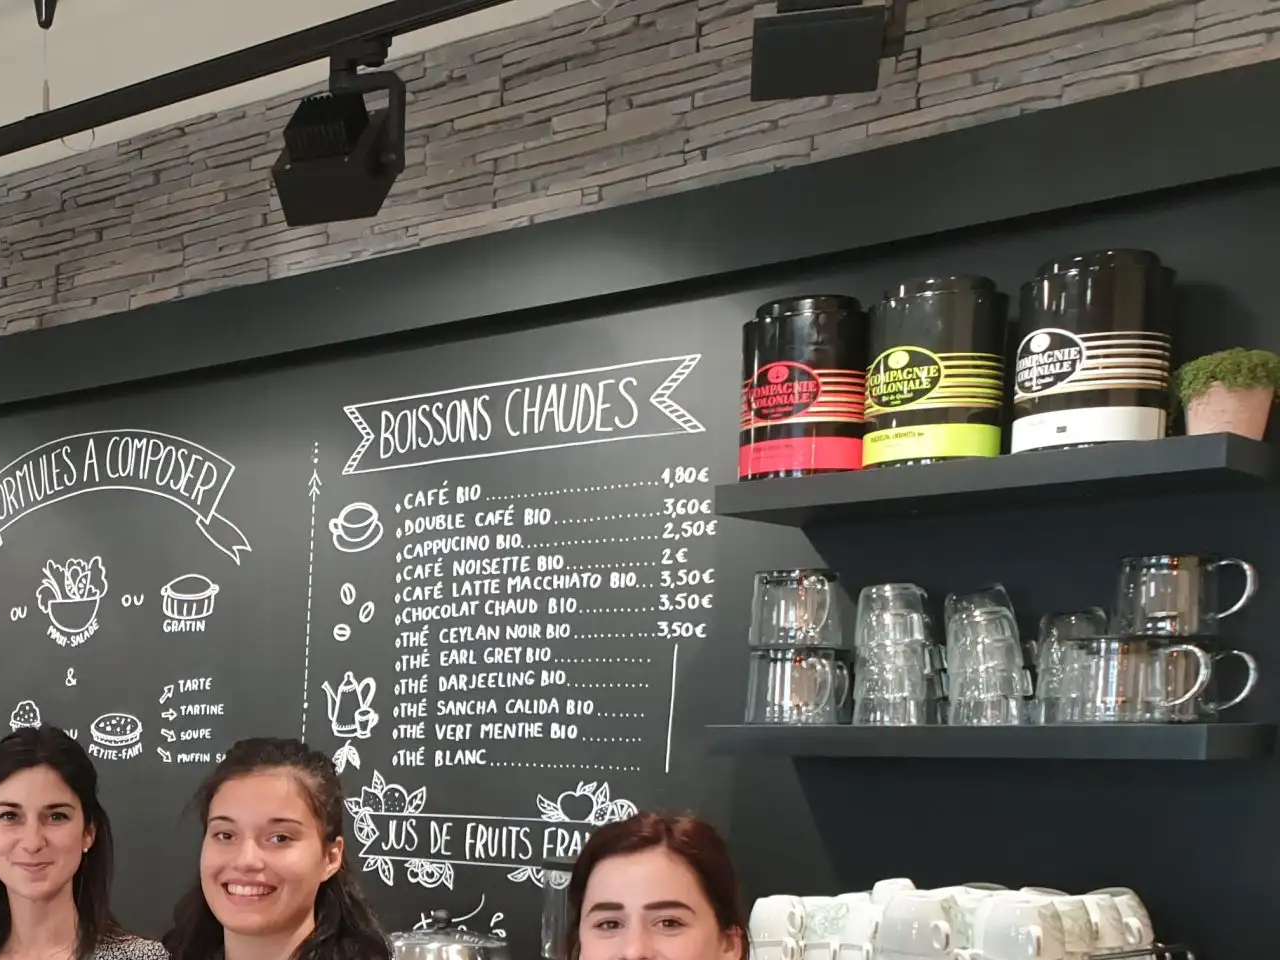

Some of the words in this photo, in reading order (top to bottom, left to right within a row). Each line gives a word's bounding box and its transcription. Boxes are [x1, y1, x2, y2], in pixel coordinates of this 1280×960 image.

[379, 395, 492, 459] BOISSONS
[504, 376, 639, 437] CHAUDES
[83, 438, 99, 483] A
[106, 436, 218, 508] COMPOSER
[404, 481, 449, 510] CAFÉ
[456, 485, 481, 505] BIO
[661, 467, 710, 489] 1,80€
[405, 512, 465, 535] DOUBLE
[475, 506, 515, 529] CAFÉ
[524, 509, 551, 526] BIO
[663, 499, 712, 519] 3,60€
[404, 535, 489, 560] CAPPUCINO
[496, 534, 521, 550] BIO
[662, 520, 718, 540] 2,50€
[404, 557, 445, 582] CAFÉ
[453, 556, 530, 576] NOISETTE
[537, 555, 564, 571] BIO
[403, 581, 443, 603] CAFÉ
[452, 577, 501, 598] LATTE
[508, 571, 602, 594] MACCHIATO
[610, 571, 636, 588] BIO
[659, 568, 715, 588] 3,50€
[402, 602, 479, 625] CHOCOLAT
[485, 598, 538, 615] CHAUD
[548, 597, 577, 614] BIO
[658, 594, 713, 611] 3,50€
[162, 619, 206, 633] GRATIN
[400, 626, 429, 648] THÉ
[439, 625, 502, 644] CEYLAN
[506, 626, 543, 640] NOIR
[546, 623, 571, 639] BIO
[657, 621, 707, 639] 3,50€
[401, 648, 430, 670] THÉ
[439, 649, 477, 666] EARL
[483, 646, 522, 663] GREY
[525, 647, 551, 662] BIO
[65, 668, 77, 688] &
[178, 677, 213, 695] TARTE
[400, 675, 428, 695] THÉ
[438, 671, 535, 692] DARJEELING
[540, 670, 566, 686] BIO
[180, 703, 224, 717] TARTINE
[399, 699, 428, 719] THÉ
[437, 700, 497, 717] SANCHA
[505, 699, 560, 715] CALIDA
[565, 699, 594, 715] BIO
[180, 728, 212, 741] SOUPE
[398, 721, 425, 740] THÉ
[434, 723, 472, 740] VERT
[480, 722, 543, 739] MENTHE
[550, 722, 577, 739] BIO
[176, 752, 211, 764] MUFFIN
[397, 746, 425, 767] THÉ
[435, 749, 487, 767] BLANC
[382, 819, 418, 852] JUS
[430, 823, 452, 855] DE
[465, 822, 532, 860] FRUITS
[543, 827, 591, 859] FRA
